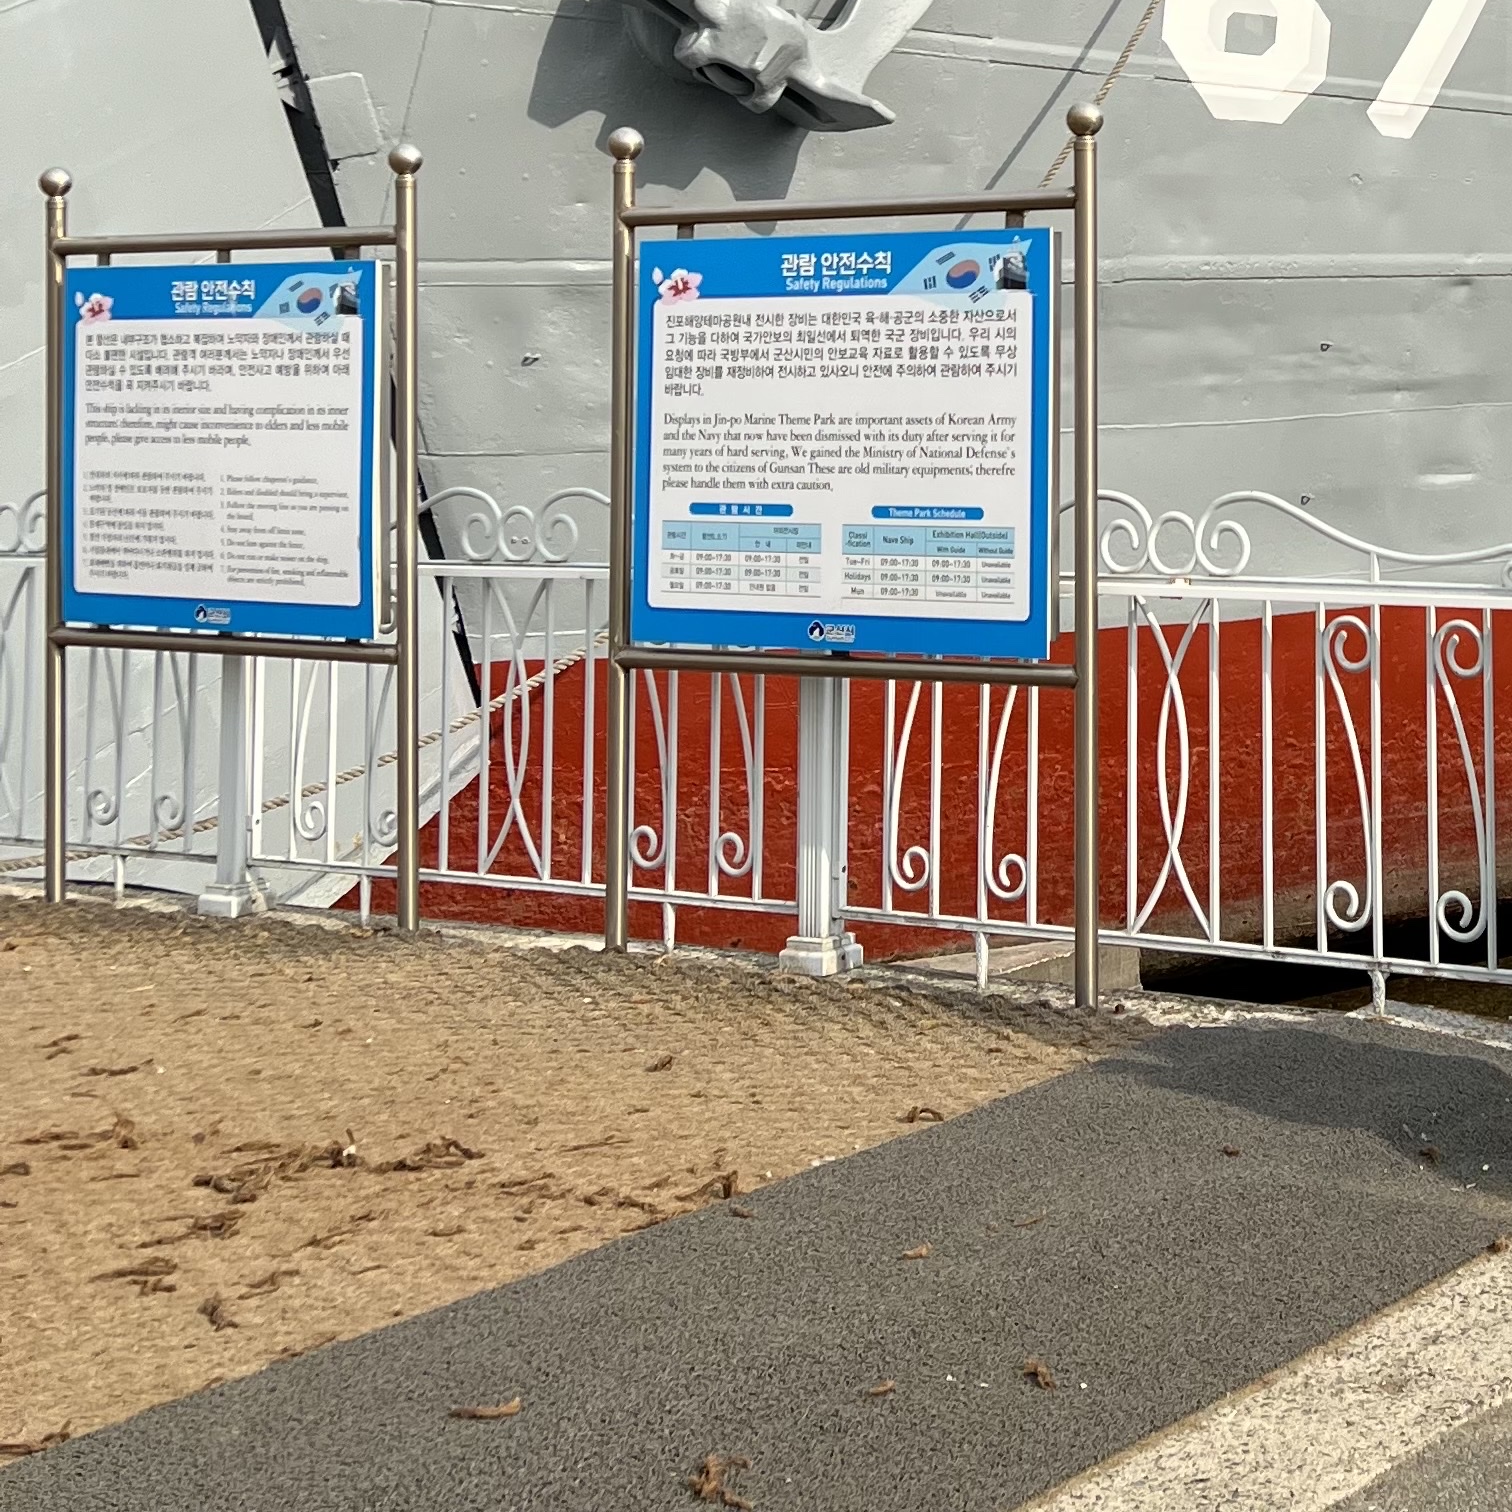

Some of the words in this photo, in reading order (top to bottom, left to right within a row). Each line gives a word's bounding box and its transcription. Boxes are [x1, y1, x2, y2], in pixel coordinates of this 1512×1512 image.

[781, 253, 817, 276] 관람
[821, 251, 892, 275] 안전수칙
[171, 281, 198, 301] 관람
[201, 280, 255, 300] 안전수칙
[786, 277, 820, 292] Safety
[822, 276, 887, 292] Regulations
[666, 314, 752, 329] 진포해양테마공원내
[754, 313, 785, 327] 전시한
[788, 312, 818, 327] 장비는
[821, 311, 862, 326] 대한민국
[927, 309, 960, 325] 소중한
[962, 309, 1017, 324] 자산으로서
[664, 333, 676, 344] 그
[678, 331, 707, 346] 기능을
[710, 331, 740, 345] 다하여
[742, 330, 793, 345] 국가안보의
[850, 328, 881, 344] 퇴역한
[884, 328, 906, 343] 국군
[968, 327, 990, 342] 우리
[994, 326, 1017, 341] 시의
[664, 348, 694, 363] 요청에
[697, 348, 717, 362] 따라
[720, 348, 770, 362] 국방부에서
[773, 347, 824, 362] 군산시민의
[827, 346, 869, 361] 안보교육
[872, 346, 904, 360] 자료로
[942, 345, 954, 360] 수
[994, 344, 1018, 360] 무상
[664, 365, 693, 380] 임대한
[695, 365, 724, 380] 장비를
[726, 365, 774, 380] 재정비하여
[777, 365, 817, 379] 전시하고
[819, 364, 859, 379] 있사오니
[862, 364, 893, 378] 안전에
[896, 363, 937, 378] 주의하여
[940, 363, 982, 378] 관람하여
[984, 362, 1018, 378] 주시기
[664, 413, 701, 429] Displays
[702, 413, 711, 425] in
[713, 413, 742, 429] Jin-po
[744, 413, 776, 425] Marine
[778, 413, 812, 426] Theme
[813, 412, 836, 426] Park
[838, 417, 853, 426] are
[855, 413, 903, 429] important
[905, 416, 933, 426] assets
[934, 413, 946, 427] of
[948, 413, 985, 426] Korean
[987, 413, 1017, 429] Army
[663, 428, 680, 441] and
[681, 428, 696, 441] the
[723, 429, 742, 441] that
[743, 433, 764, 441] now
[766, 429, 788, 441] have
[790, 429, 813, 442] been
[814, 429, 861, 442] dismissed
[863, 429, 886, 442] with
[888, 429, 900, 442] its
[901, 429, 924, 446] duty
[926, 429, 950, 442] after
[951, 429, 988, 446] serving
[990, 429, 998, 442] it
[1000, 429, 1016, 442] for
[662, 448, 688, 460] many
[689, 448, 713, 461] years
[714, 444, 725, 457] of
[726, 444, 749, 458] hard
[790, 445, 808, 458] We
[809, 445, 842, 461] gained
[844, 445, 860, 458] the
[862, 445, 904, 462] Ministry
[906, 445, 918, 459] of
[919, 446, 963, 459] National
[662, 463, 692, 477] system
[694, 464, 704, 473] to
[705, 460, 720, 473] the
[721, 461, 756, 473] citizens
[757, 461, 768, 473] of
[769, 461, 806, 474] Gunsan
[807, 462, 836, 474] These
[837, 466, 853, 475] are
[854, 461, 870, 475] old
[872, 462, 910, 478] military
[662, 476, 689, 492] please
[690, 476, 721, 489] handle
[722, 477, 746, 489] them
[748, 477, 769, 489] with
[770, 481, 795, 490] extra
[888, 508, 912, 518] Theme
[914, 508, 931, 518] Park
[933, 509, 966, 519] Schedule
[900, 536, 914, 545] Ship
[932, 531, 964, 539] Exhibition
[844, 572, 871, 581] Holidays
